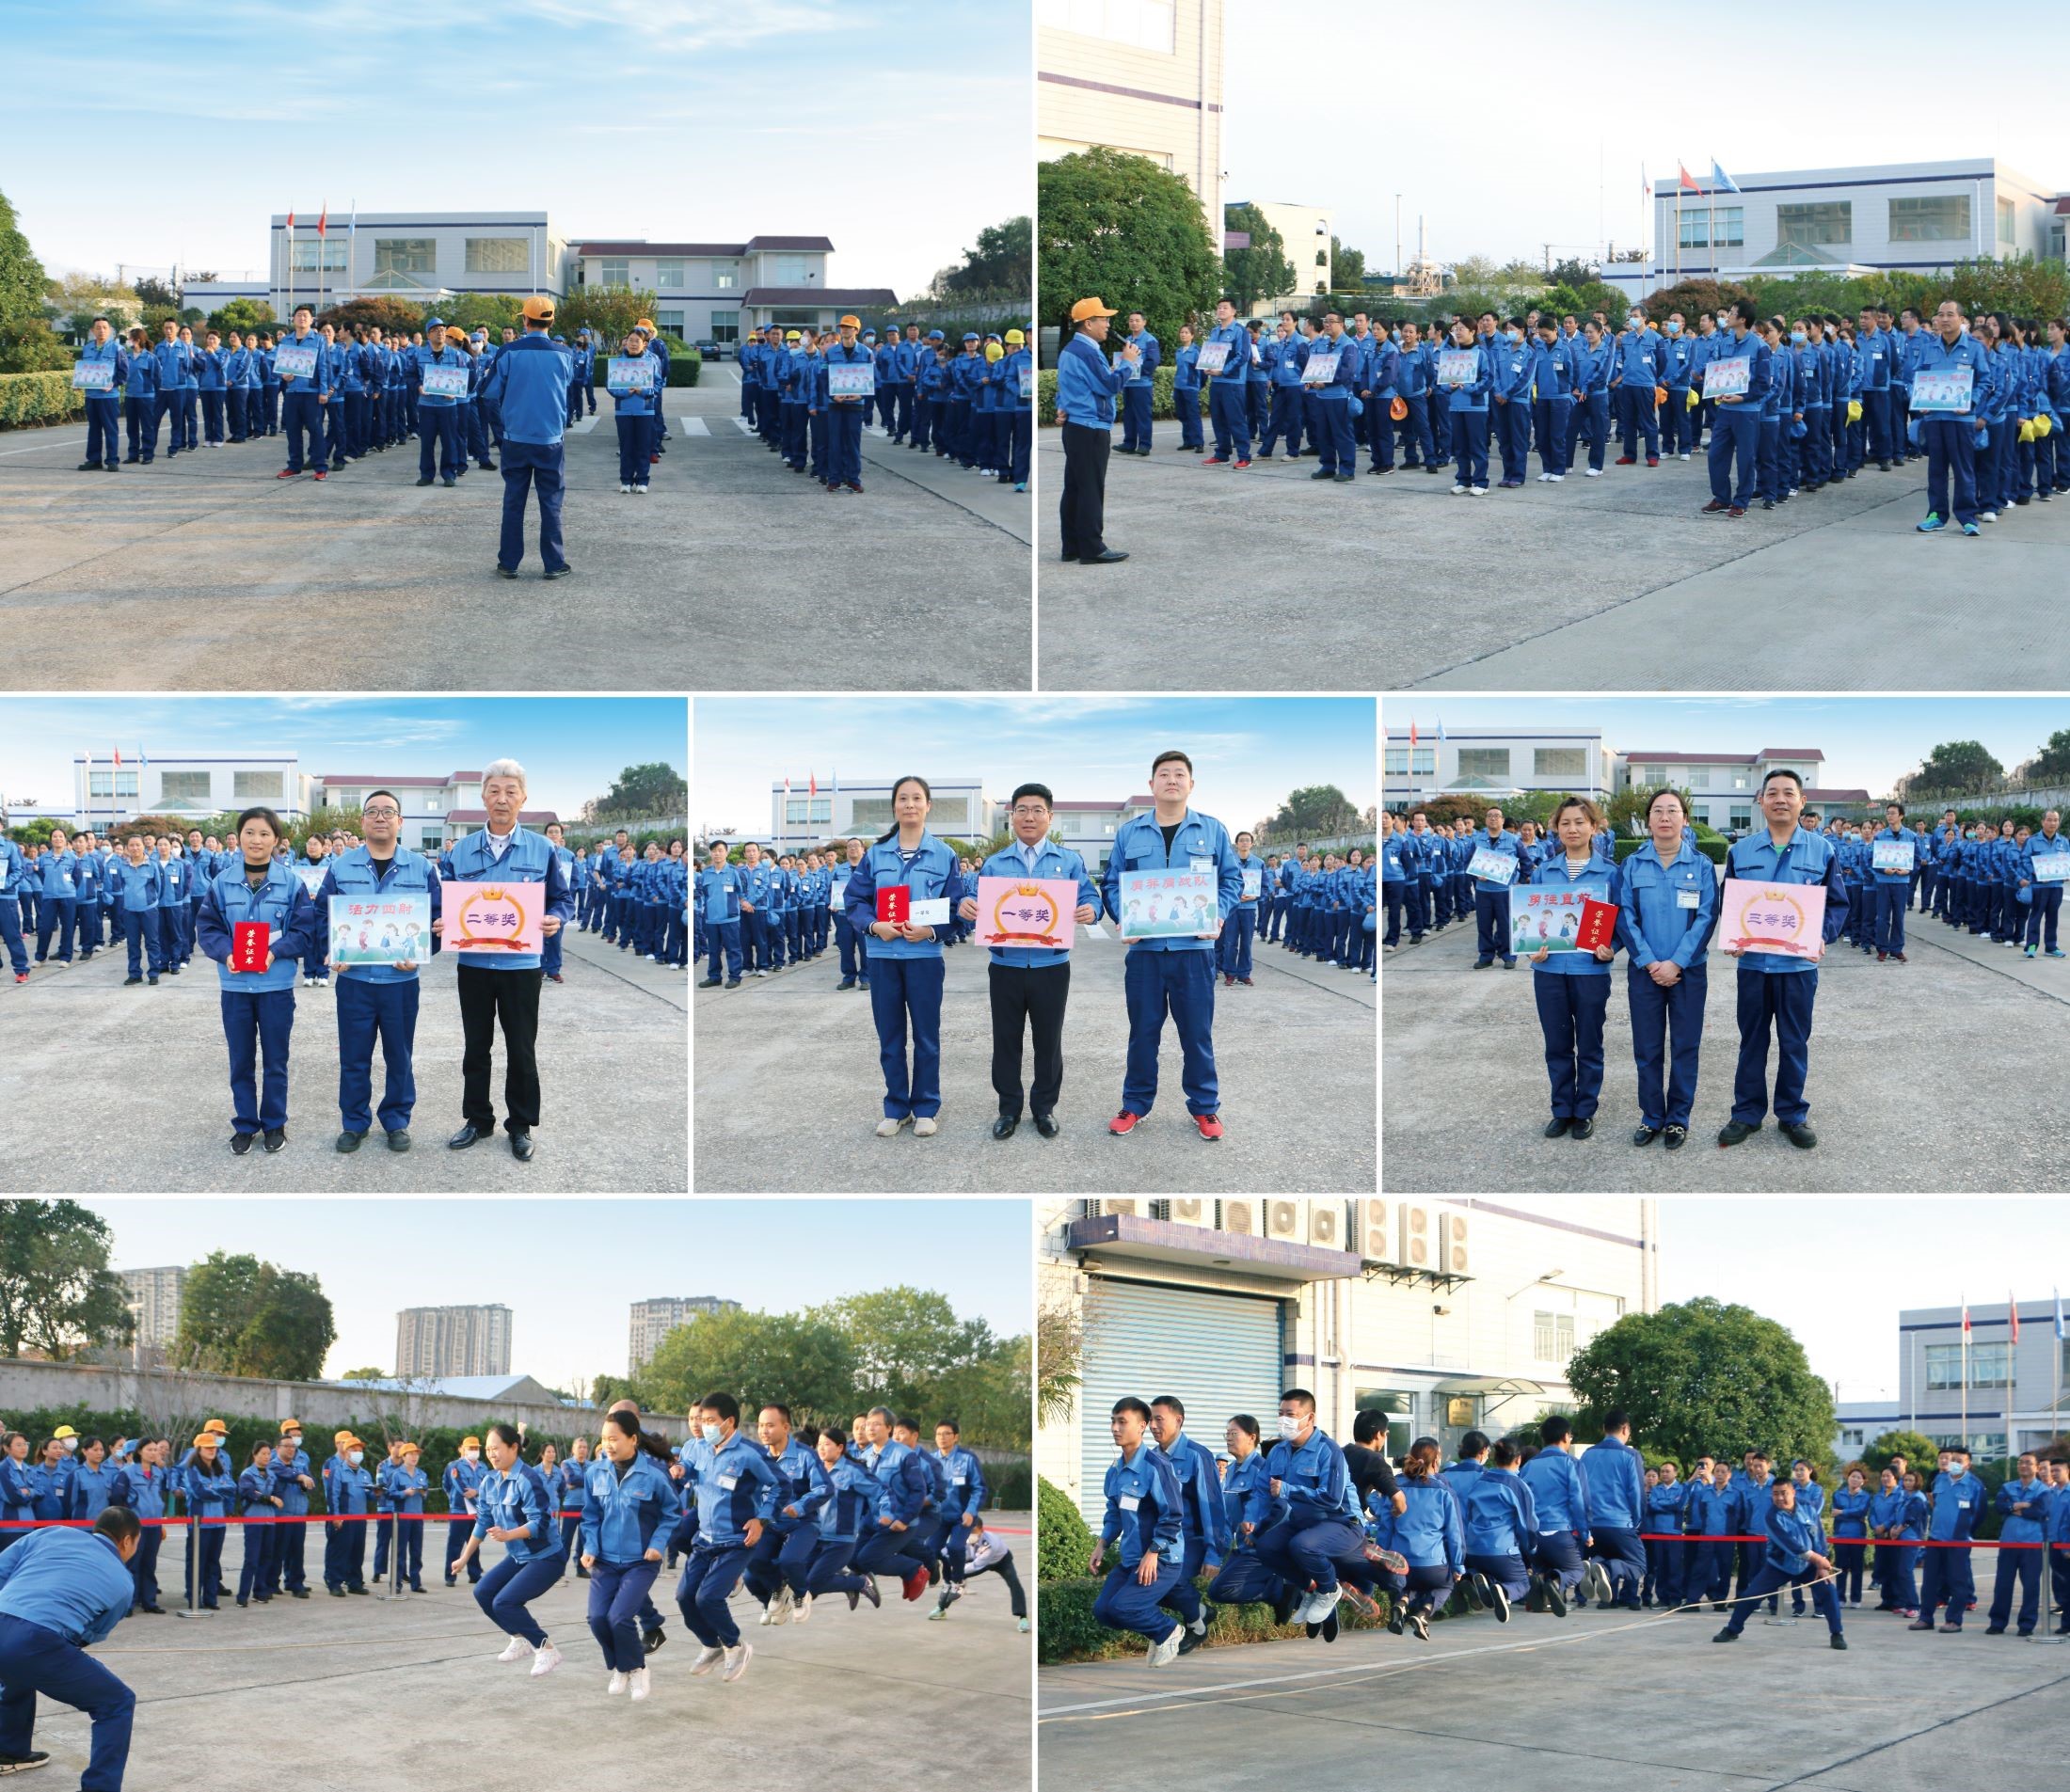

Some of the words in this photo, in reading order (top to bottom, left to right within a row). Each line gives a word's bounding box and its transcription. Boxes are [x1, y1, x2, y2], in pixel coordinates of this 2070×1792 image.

[347, 903, 413, 915] 活力四射
[1001, 909, 1049, 922] 一等奖
[466, 912, 517, 927] 二等奖
[1589, 910, 1604, 944] 荣誉证书
[1747, 912, 1796, 928] 三等奖
[246, 928, 256, 965] 荣誉证书
